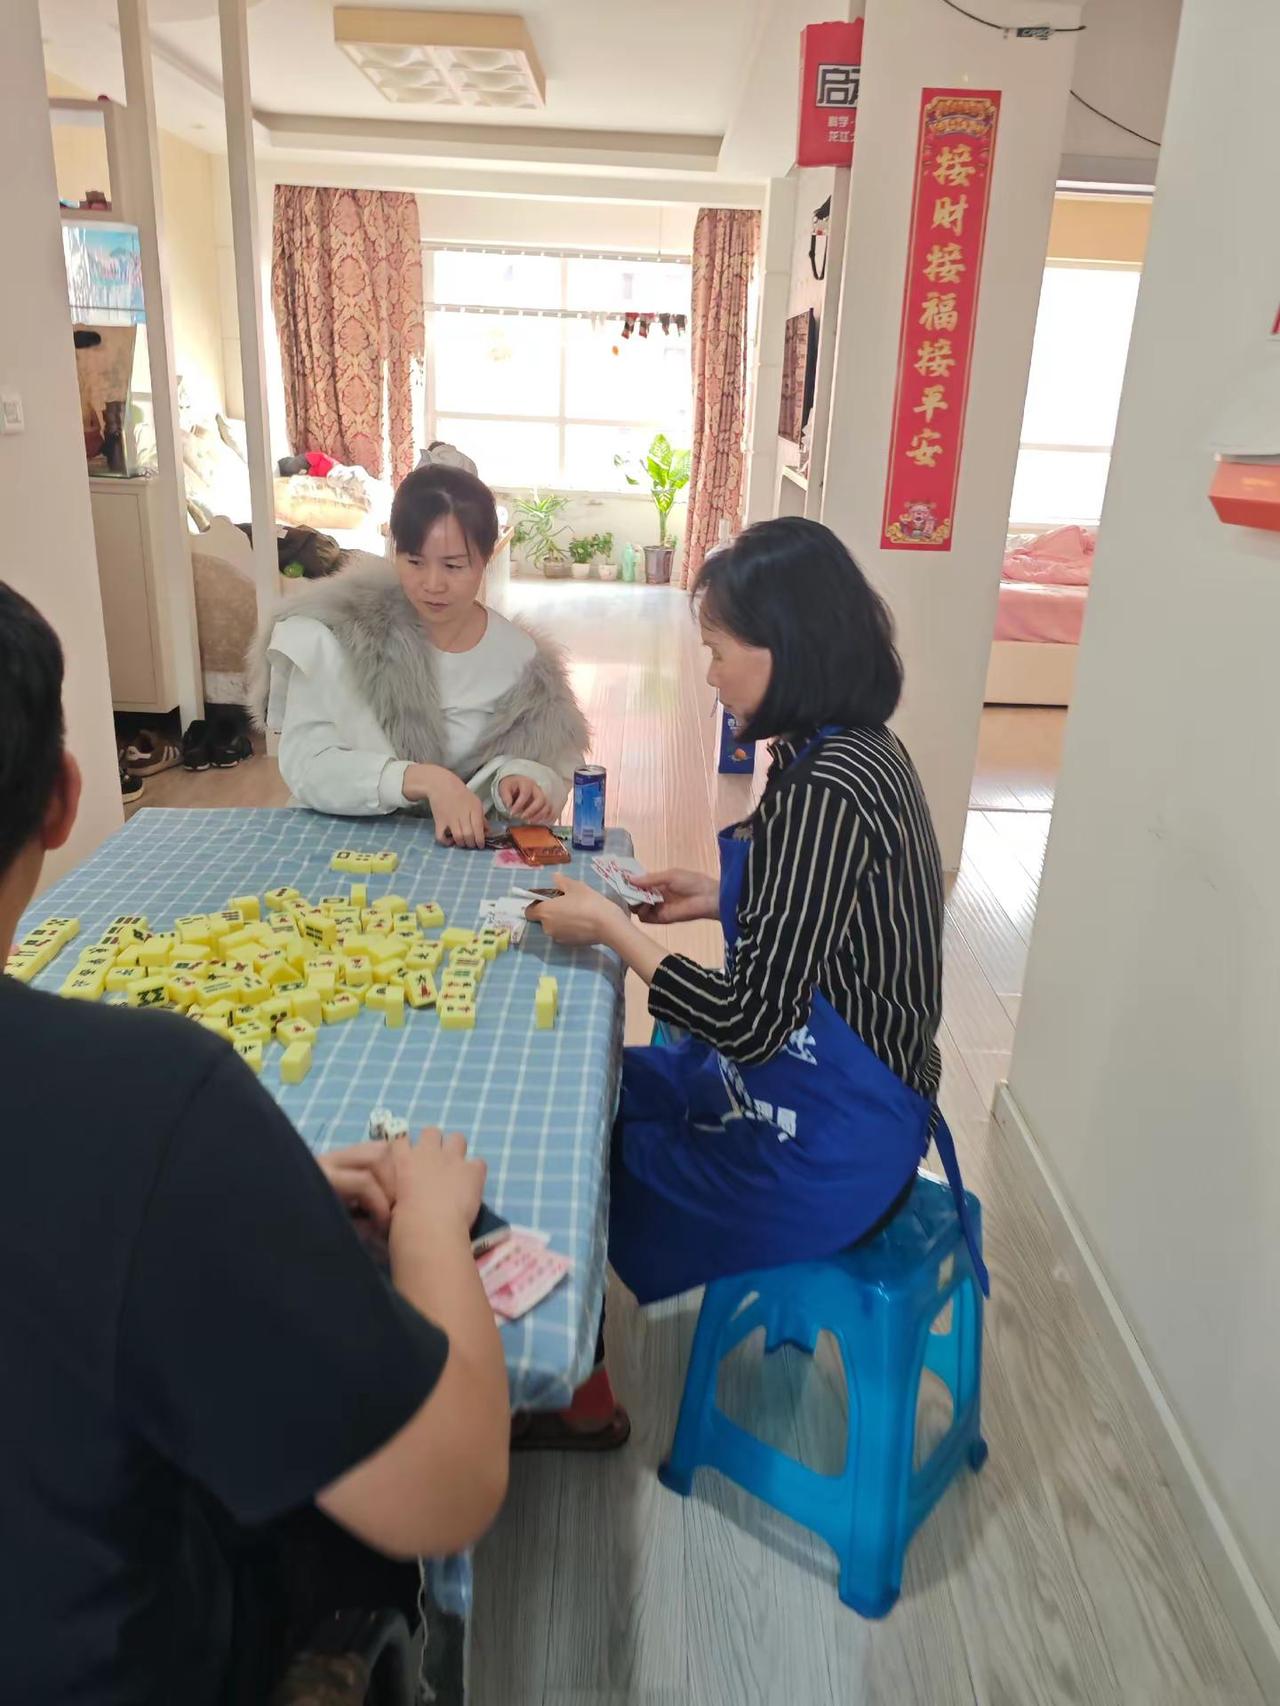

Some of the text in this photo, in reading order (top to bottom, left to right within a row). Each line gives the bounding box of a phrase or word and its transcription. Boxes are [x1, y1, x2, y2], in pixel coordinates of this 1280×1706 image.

[905, 143, 976, 468] 接财接福接平安
